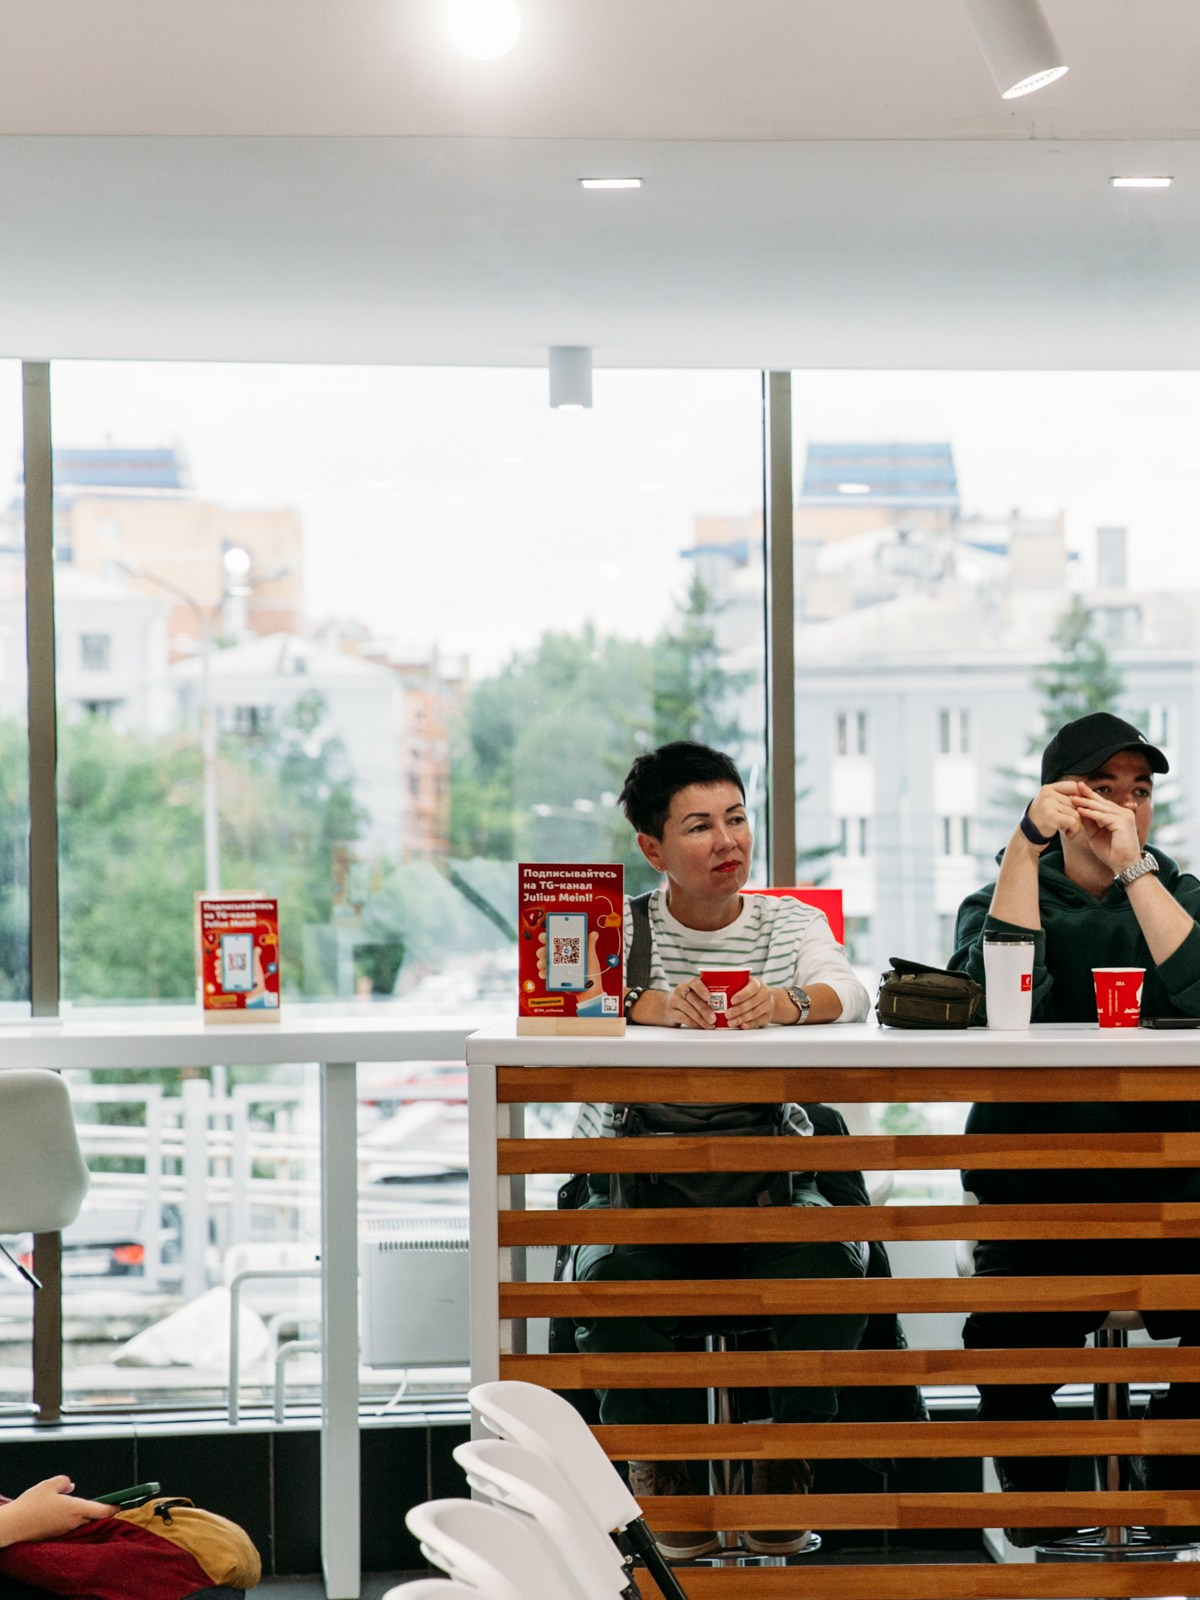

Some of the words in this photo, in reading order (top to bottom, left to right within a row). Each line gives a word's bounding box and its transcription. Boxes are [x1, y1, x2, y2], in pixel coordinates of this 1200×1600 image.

[523, 868, 617, 878] Подписывайтесь
[523, 882, 537, 890] на
[539, 881, 593, 890] TG-канал
[523, 892, 556, 902] Julius
[558, 892, 593, 902] Meinl!
